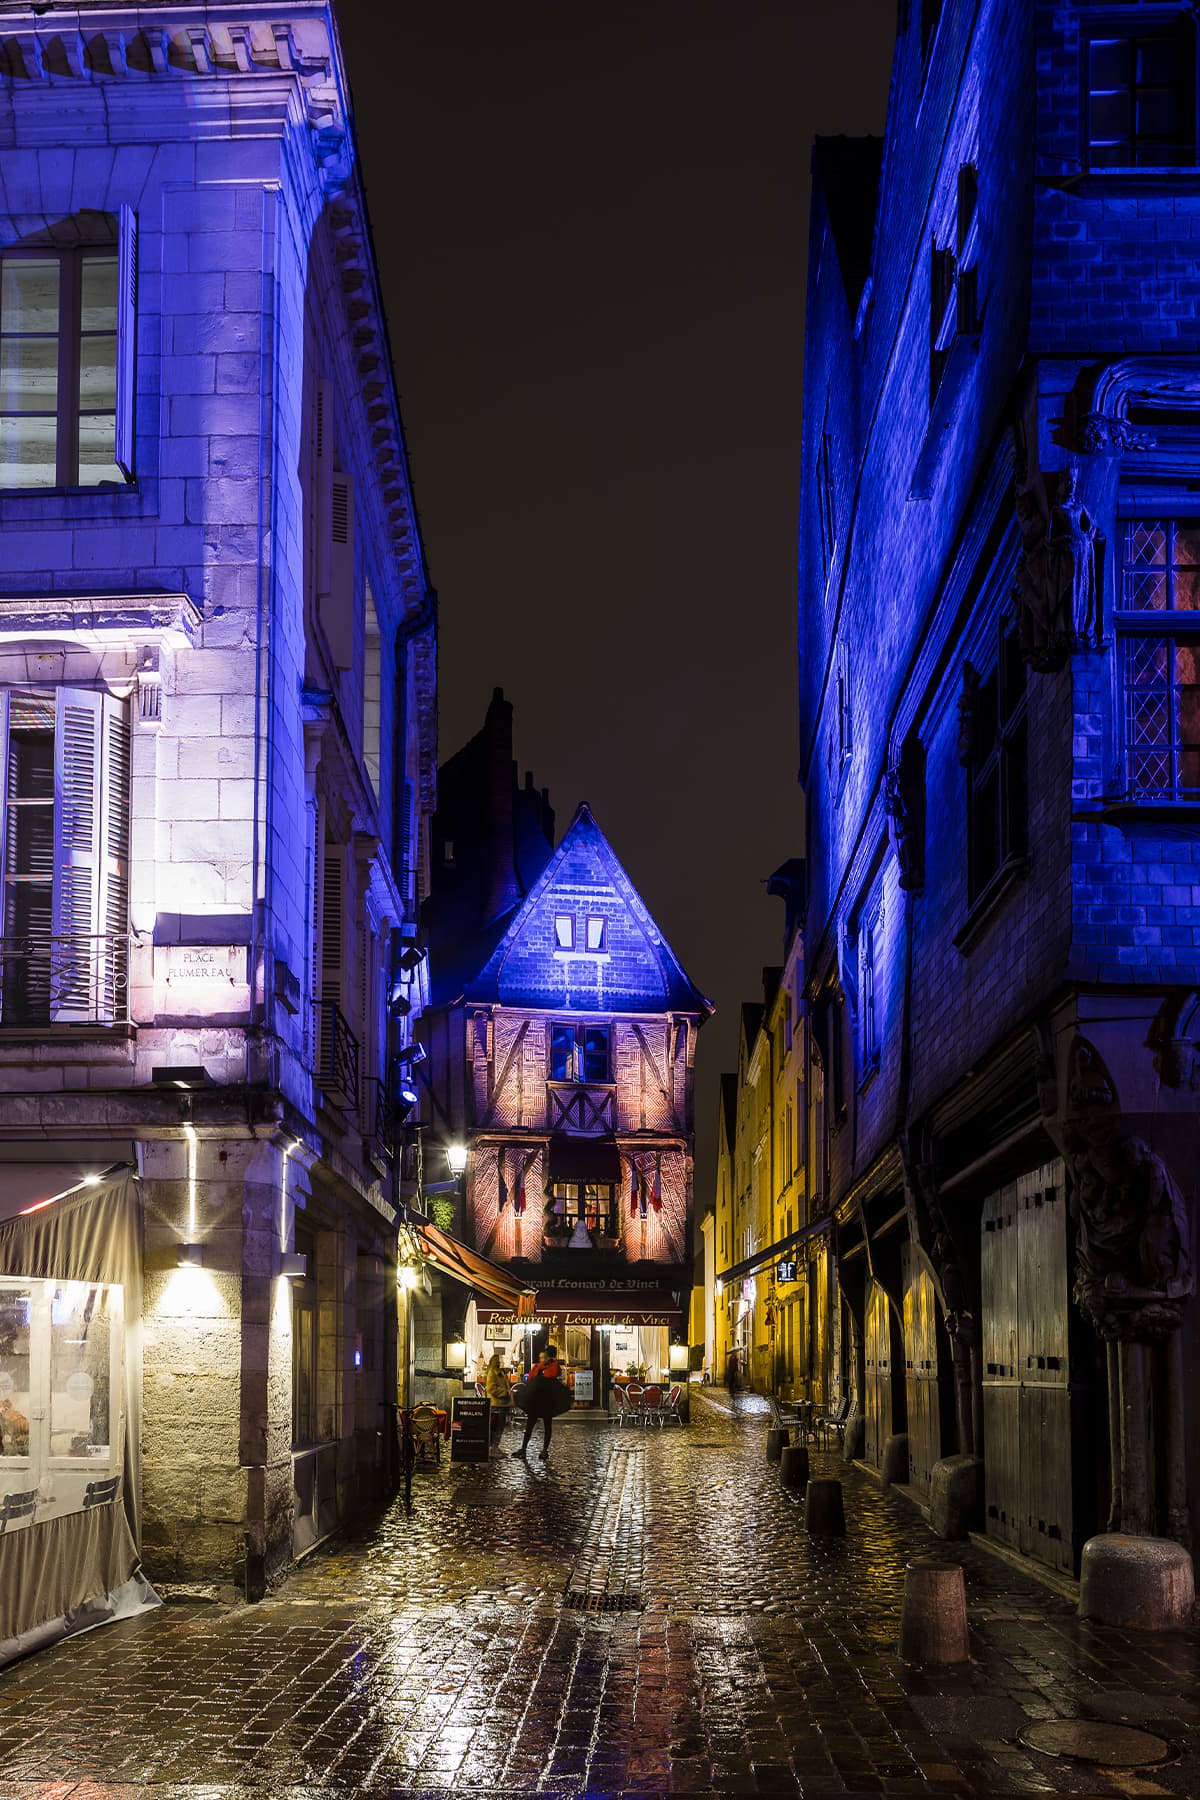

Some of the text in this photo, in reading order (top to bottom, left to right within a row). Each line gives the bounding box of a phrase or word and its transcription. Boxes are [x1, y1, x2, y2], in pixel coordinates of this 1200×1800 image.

[183, 953, 215, 963] PLACE
[168, 968, 232, 978] PLUMEREAU
[609, 1280, 625, 1289] de
[489, 1312, 670, 1325] Restaurant Léonard de Vinci
